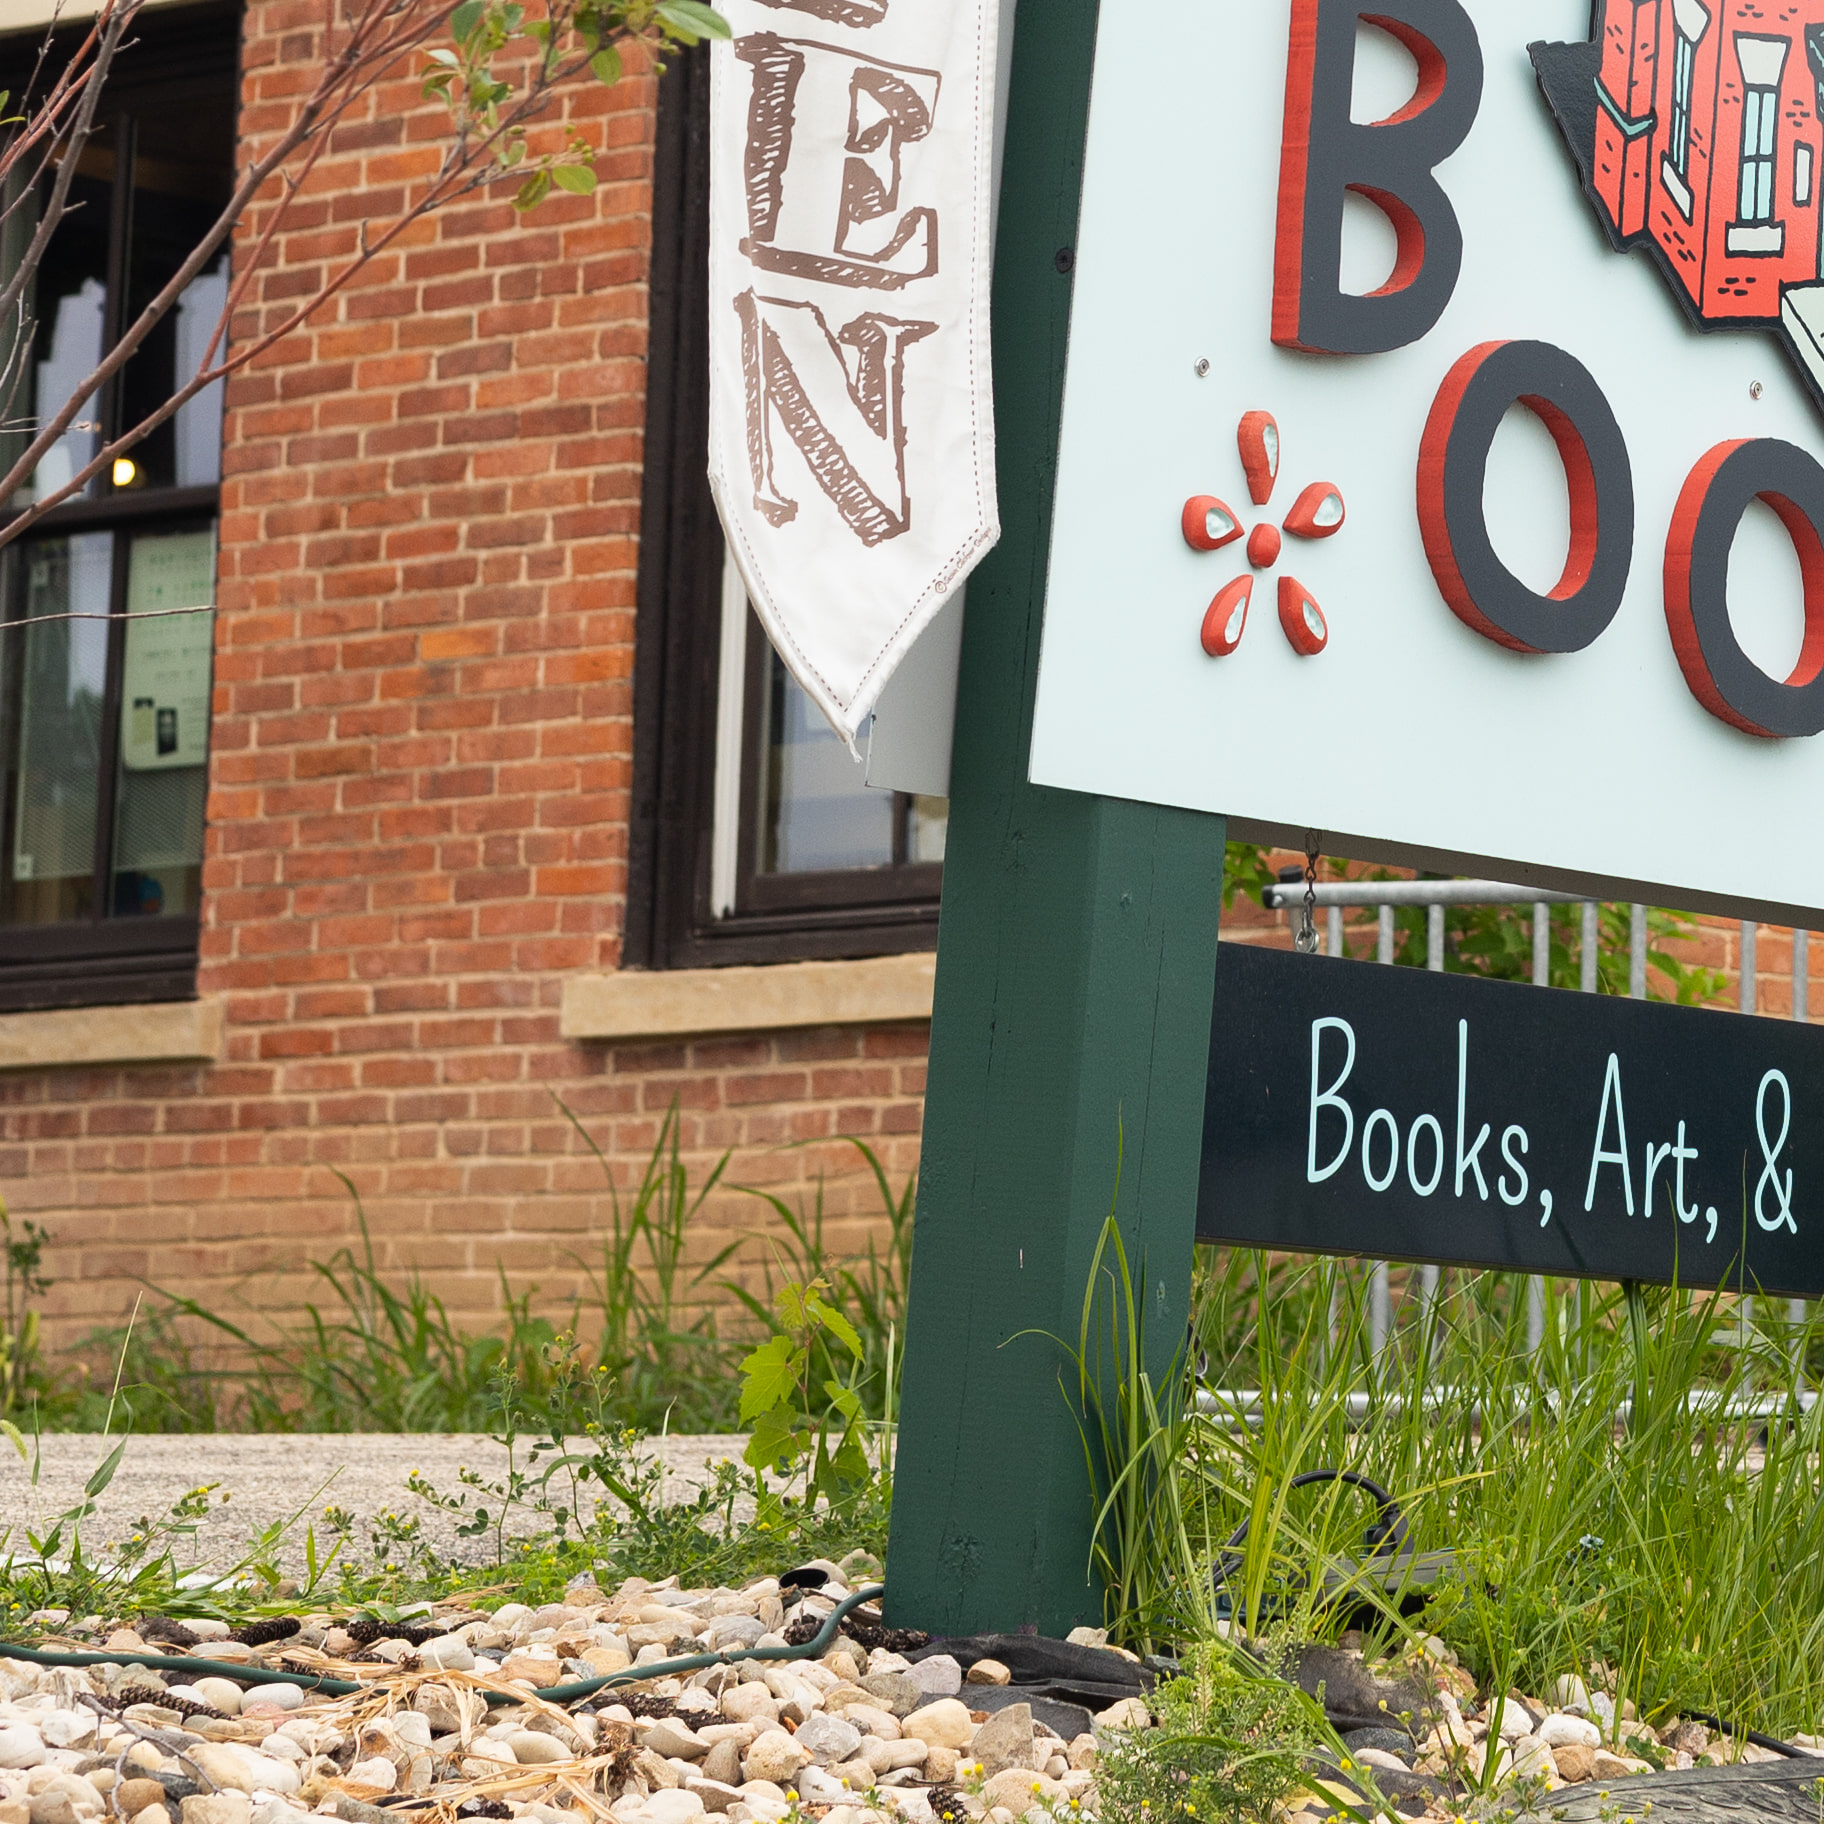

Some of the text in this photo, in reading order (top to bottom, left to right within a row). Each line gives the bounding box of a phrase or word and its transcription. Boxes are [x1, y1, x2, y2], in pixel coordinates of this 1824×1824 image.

[1306, 1016, 1553, 1228] Books,
[1584, 1052, 1719, 1244] Art,
[1753, 1068, 1798, 1235] &
